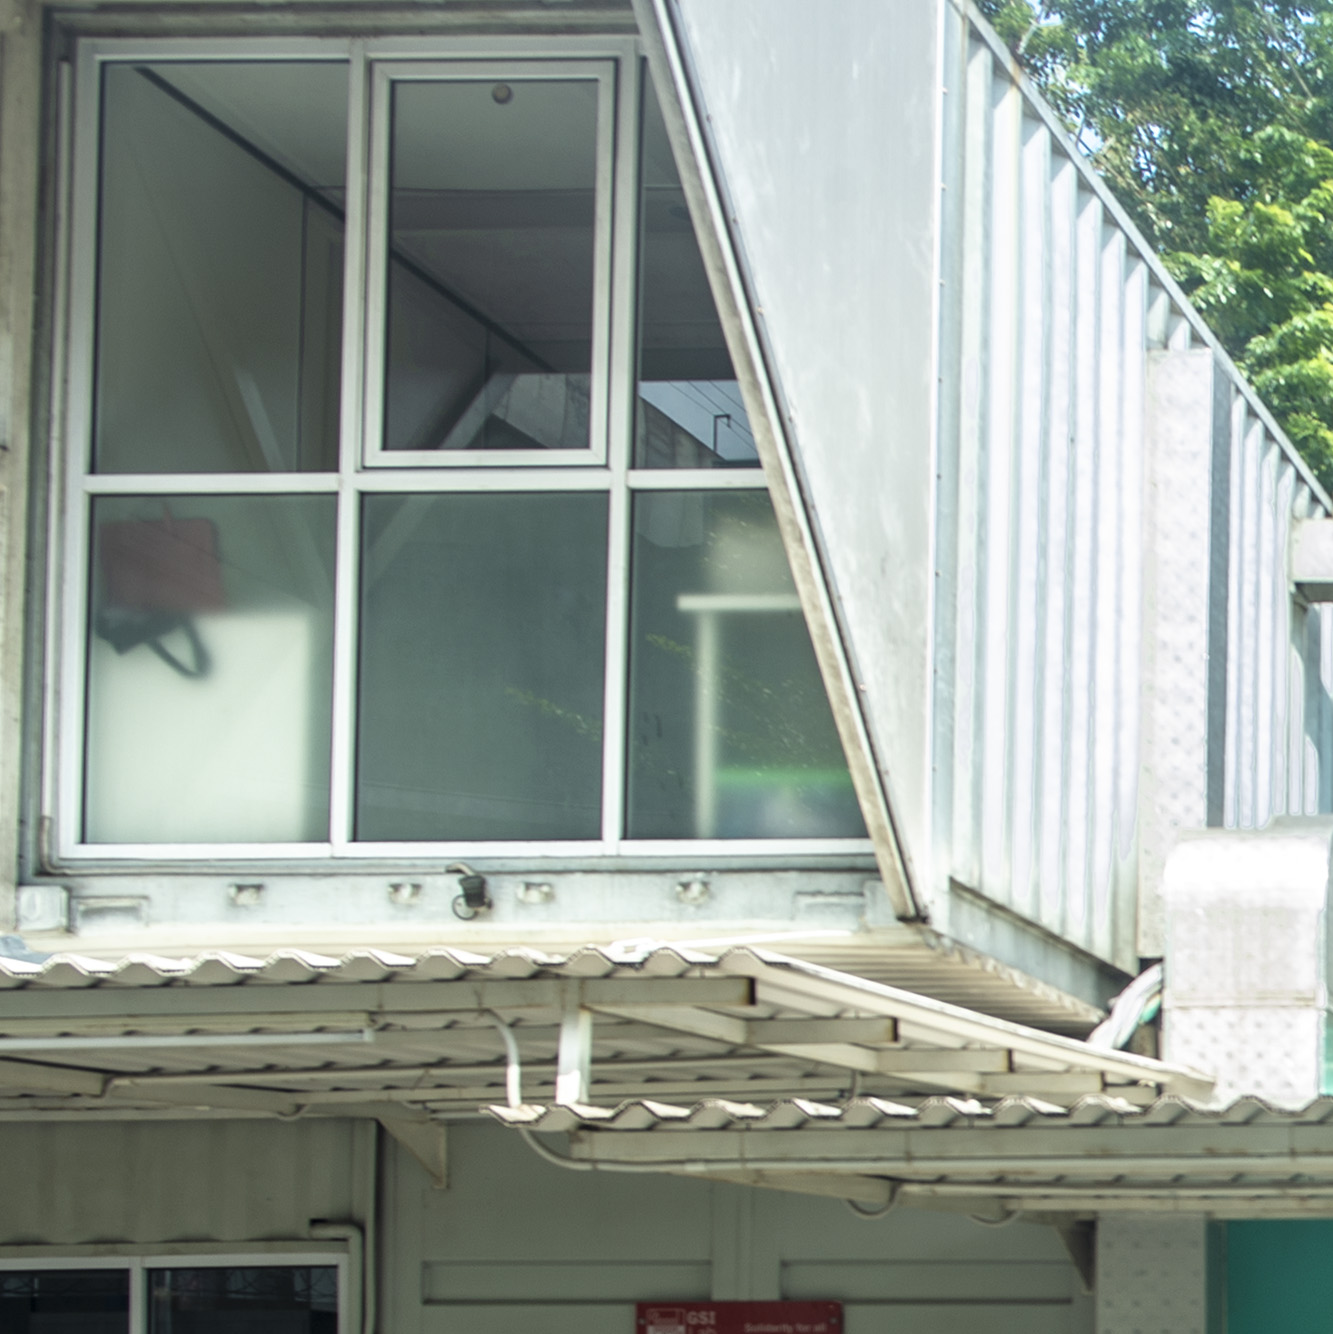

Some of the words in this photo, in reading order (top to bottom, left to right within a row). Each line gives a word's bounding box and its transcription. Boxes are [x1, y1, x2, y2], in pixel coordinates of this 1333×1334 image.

[686, 1310, 716, 1326] GSI
[743, 1322, 793, 1334] Solidarity
[795, 1322, 811, 1333] for
